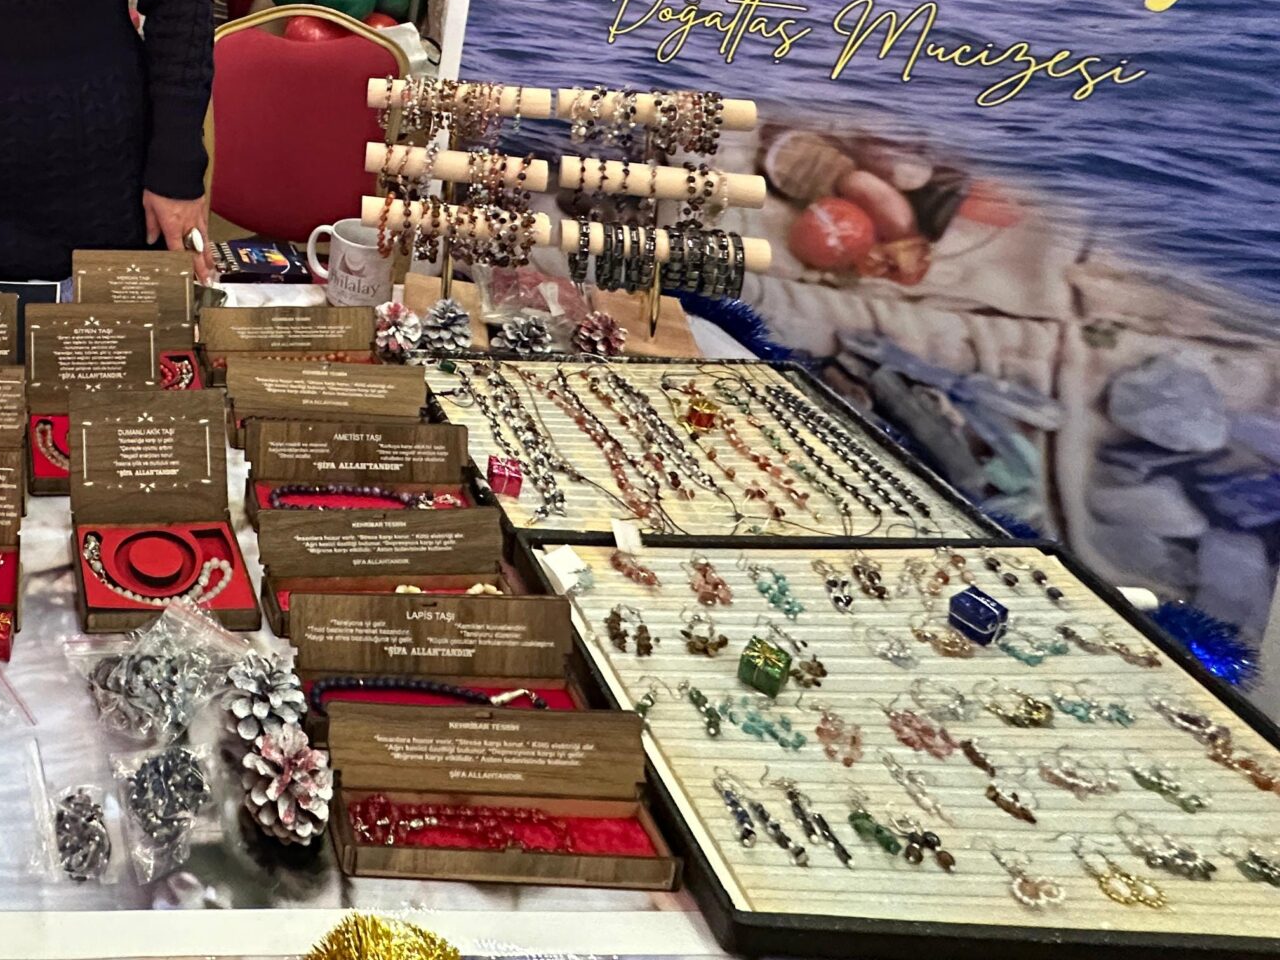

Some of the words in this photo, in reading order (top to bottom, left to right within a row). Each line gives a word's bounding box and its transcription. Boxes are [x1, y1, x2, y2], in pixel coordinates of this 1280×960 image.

[161, 428, 175, 436] TAŞI
[334, 432, 364, 441] AMETİST
[366, 434, 382, 442] TAŞI
[313, 460, 336, 471] "ŞİFA
[406, 610, 432, 620] LAPİS
[435, 612, 456, 623] TAŞI
[384, 645, 408, 658] "ŞİFA
[448, 722, 489, 730] KEHRİBAR
[448, 770, 466, 779] ŞİFA
